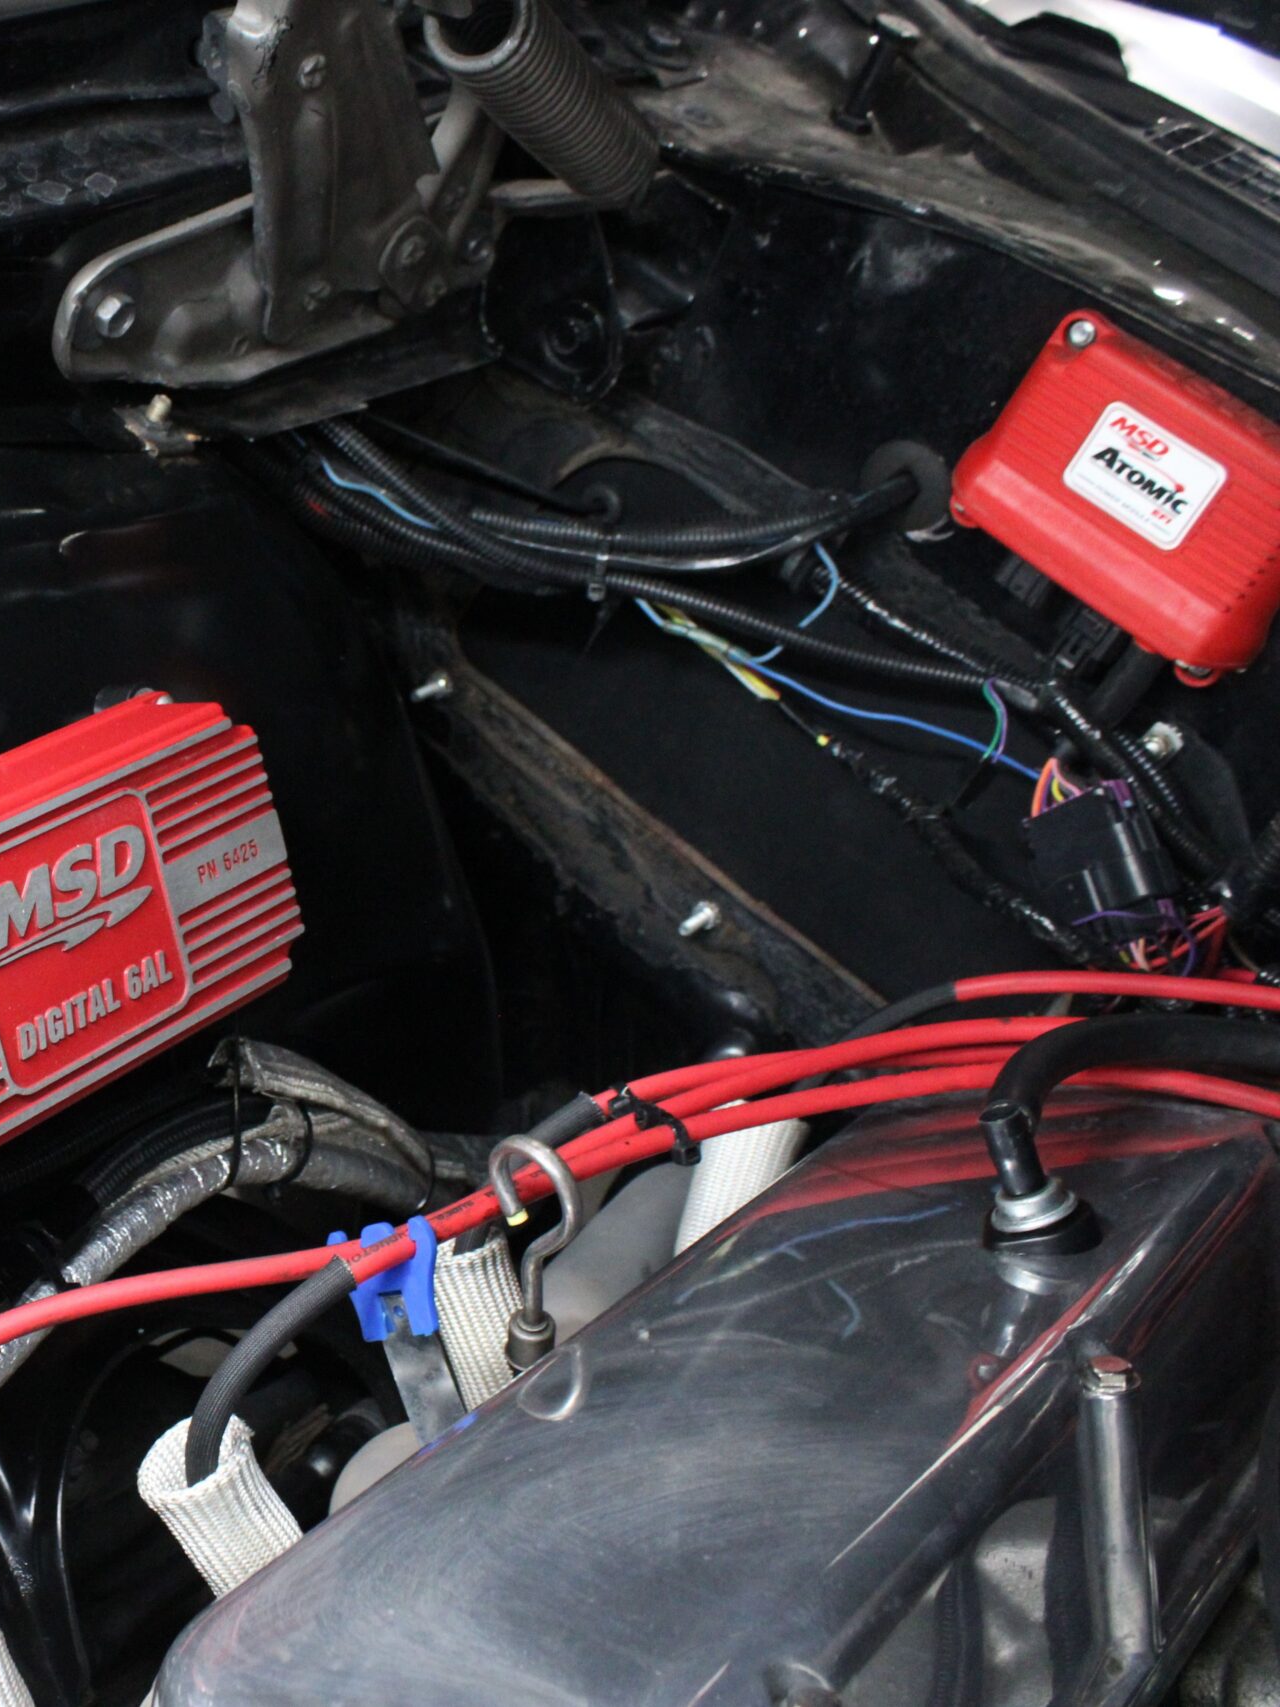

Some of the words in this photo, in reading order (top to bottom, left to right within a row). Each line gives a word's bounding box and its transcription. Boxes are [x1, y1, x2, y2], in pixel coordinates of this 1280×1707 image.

[1110, 416, 1169, 456] MSD
[1151, 508, 1174, 525] EFI
[196, 860, 219, 885] PN
[222, 838, 260, 872] 6425
[16, 978, 122, 1060] DIGITAL
[123, 950, 173, 1000] 6AL
